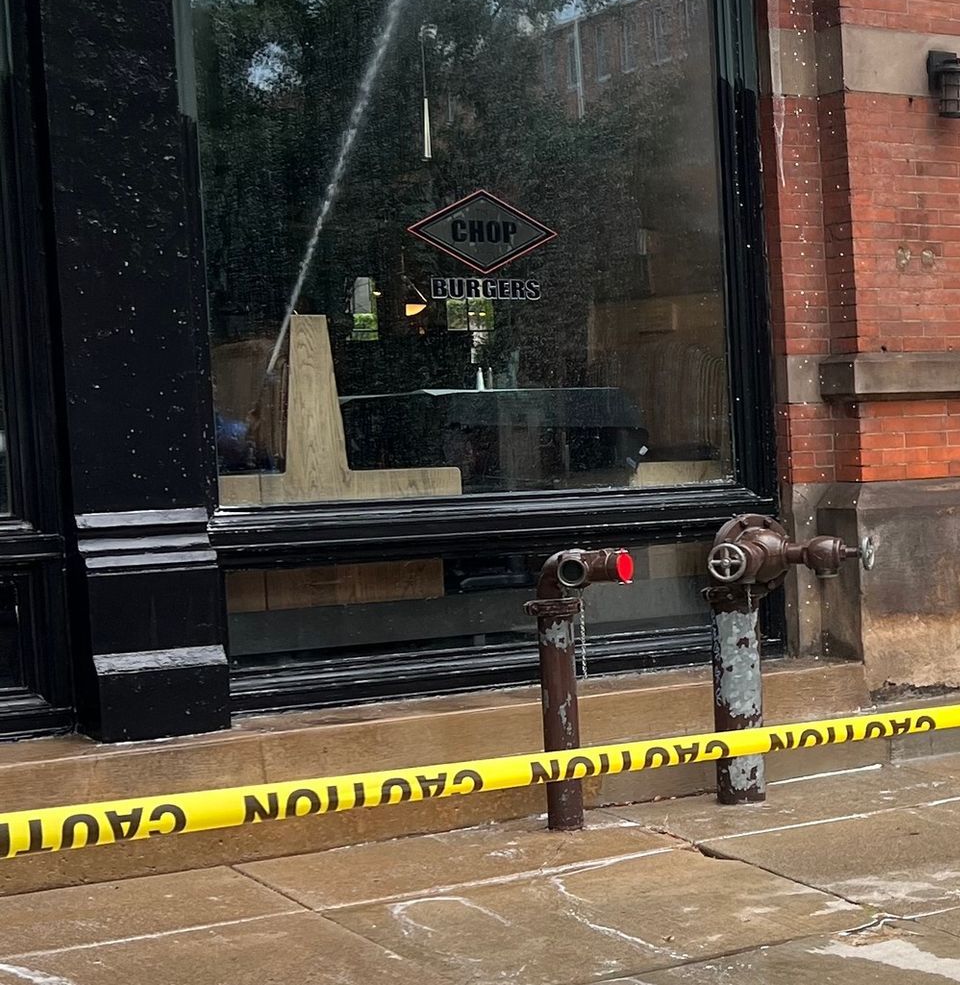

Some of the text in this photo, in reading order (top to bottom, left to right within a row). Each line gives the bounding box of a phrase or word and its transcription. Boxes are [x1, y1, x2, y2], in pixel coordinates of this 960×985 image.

[451, 219, 517, 244] CHOP
[430, 277, 542, 301] BURGERS
[768, 715, 937, 754] CAUTION
[530, 739, 730, 784] CAUTION
[243, 769, 484, 824] CAUTION
